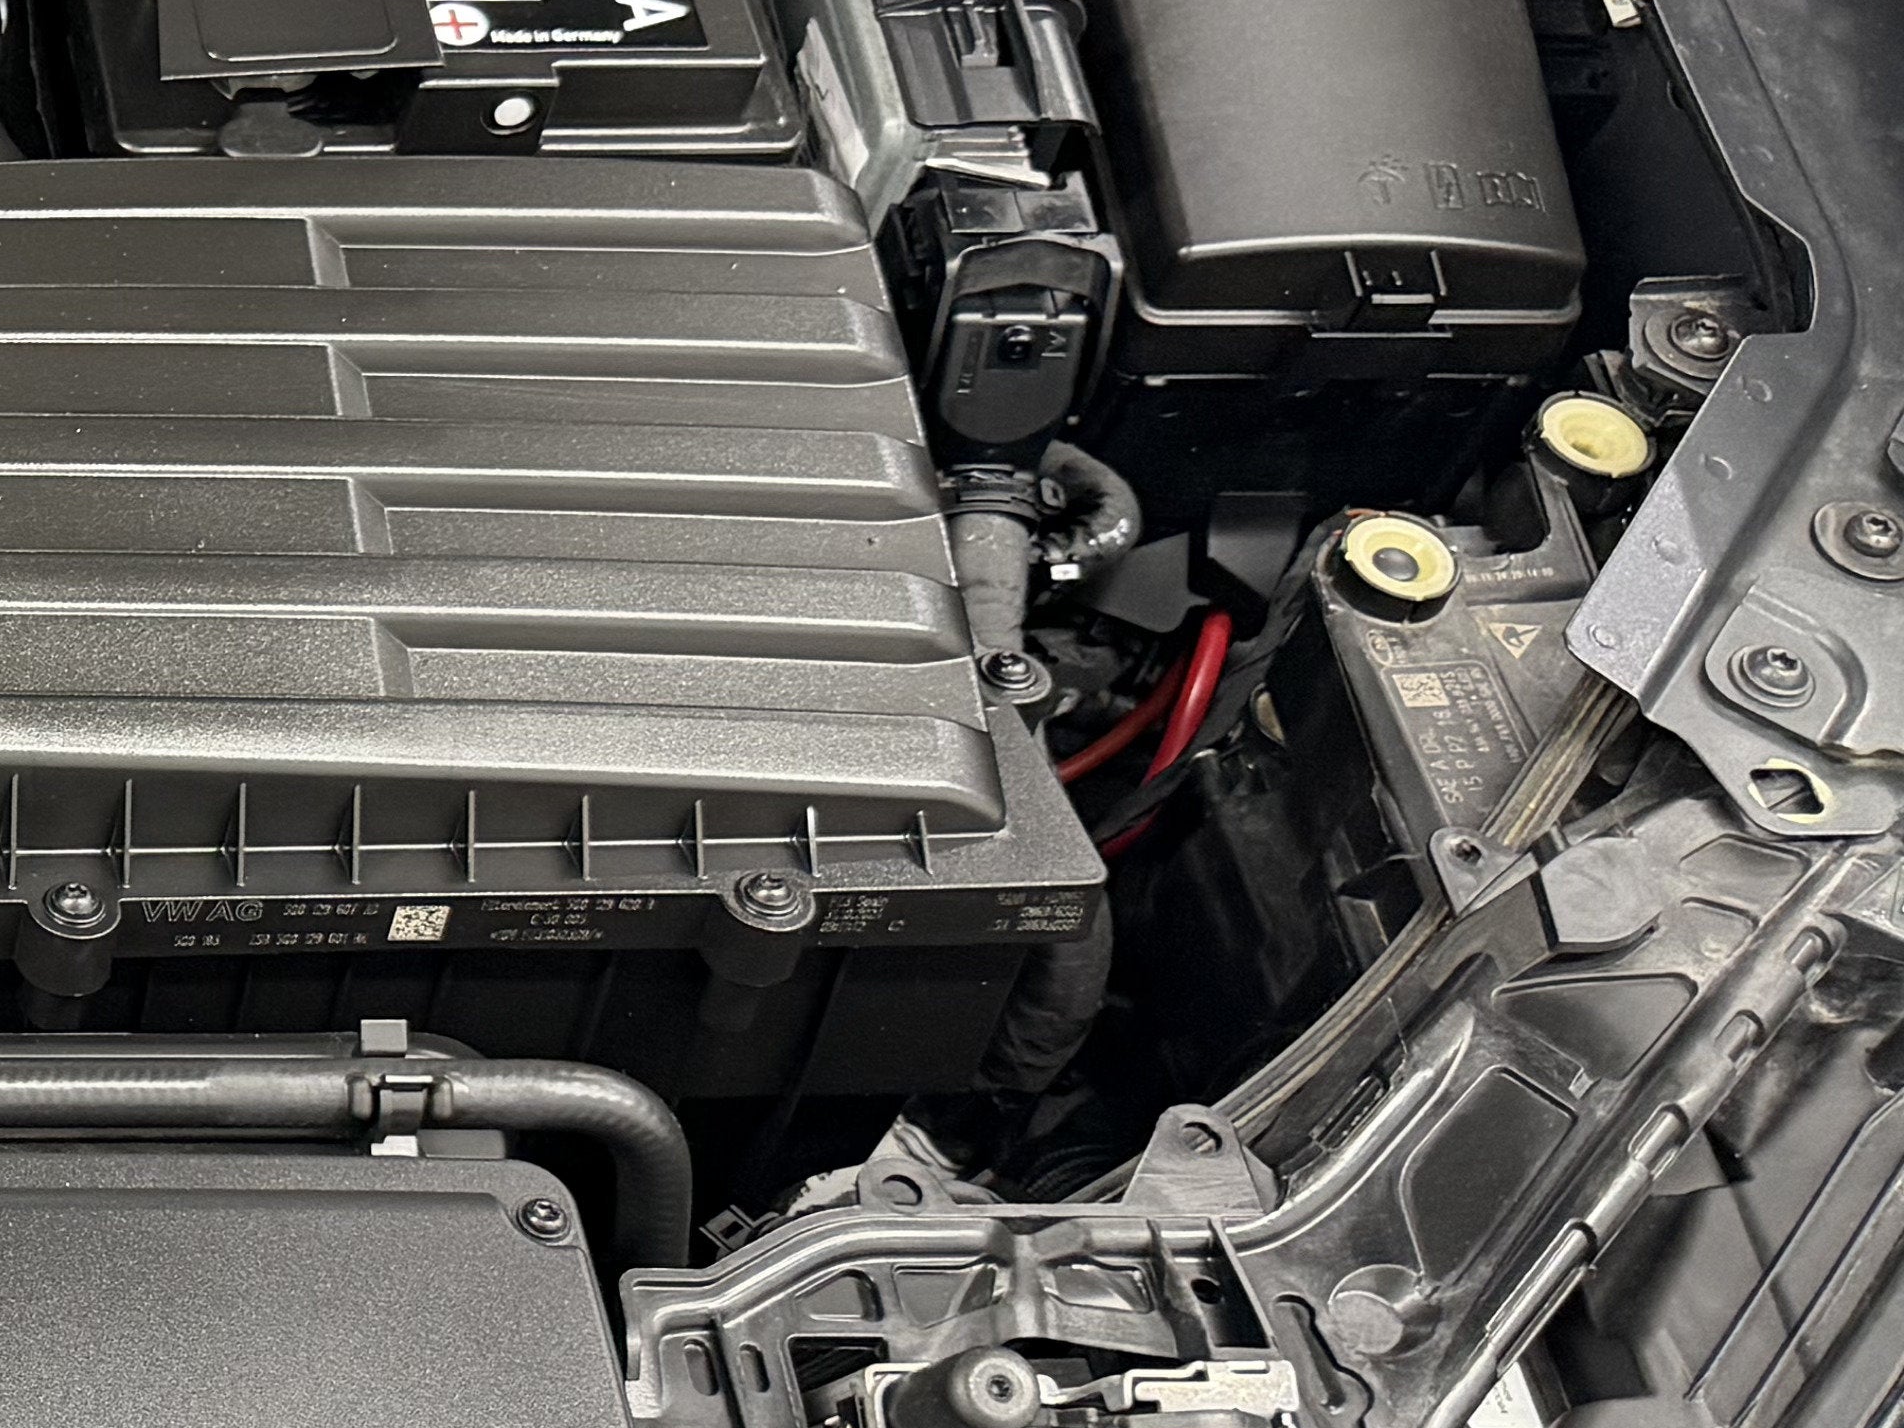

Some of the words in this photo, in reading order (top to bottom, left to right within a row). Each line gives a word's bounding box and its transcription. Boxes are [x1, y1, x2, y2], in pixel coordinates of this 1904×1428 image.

[490, 28, 532, 43] Made
[533, 28, 550, 42] in
[551, 28, 624, 44] Germany
[142, 901, 203, 922] VW
[206, 900, 264, 922] AG
